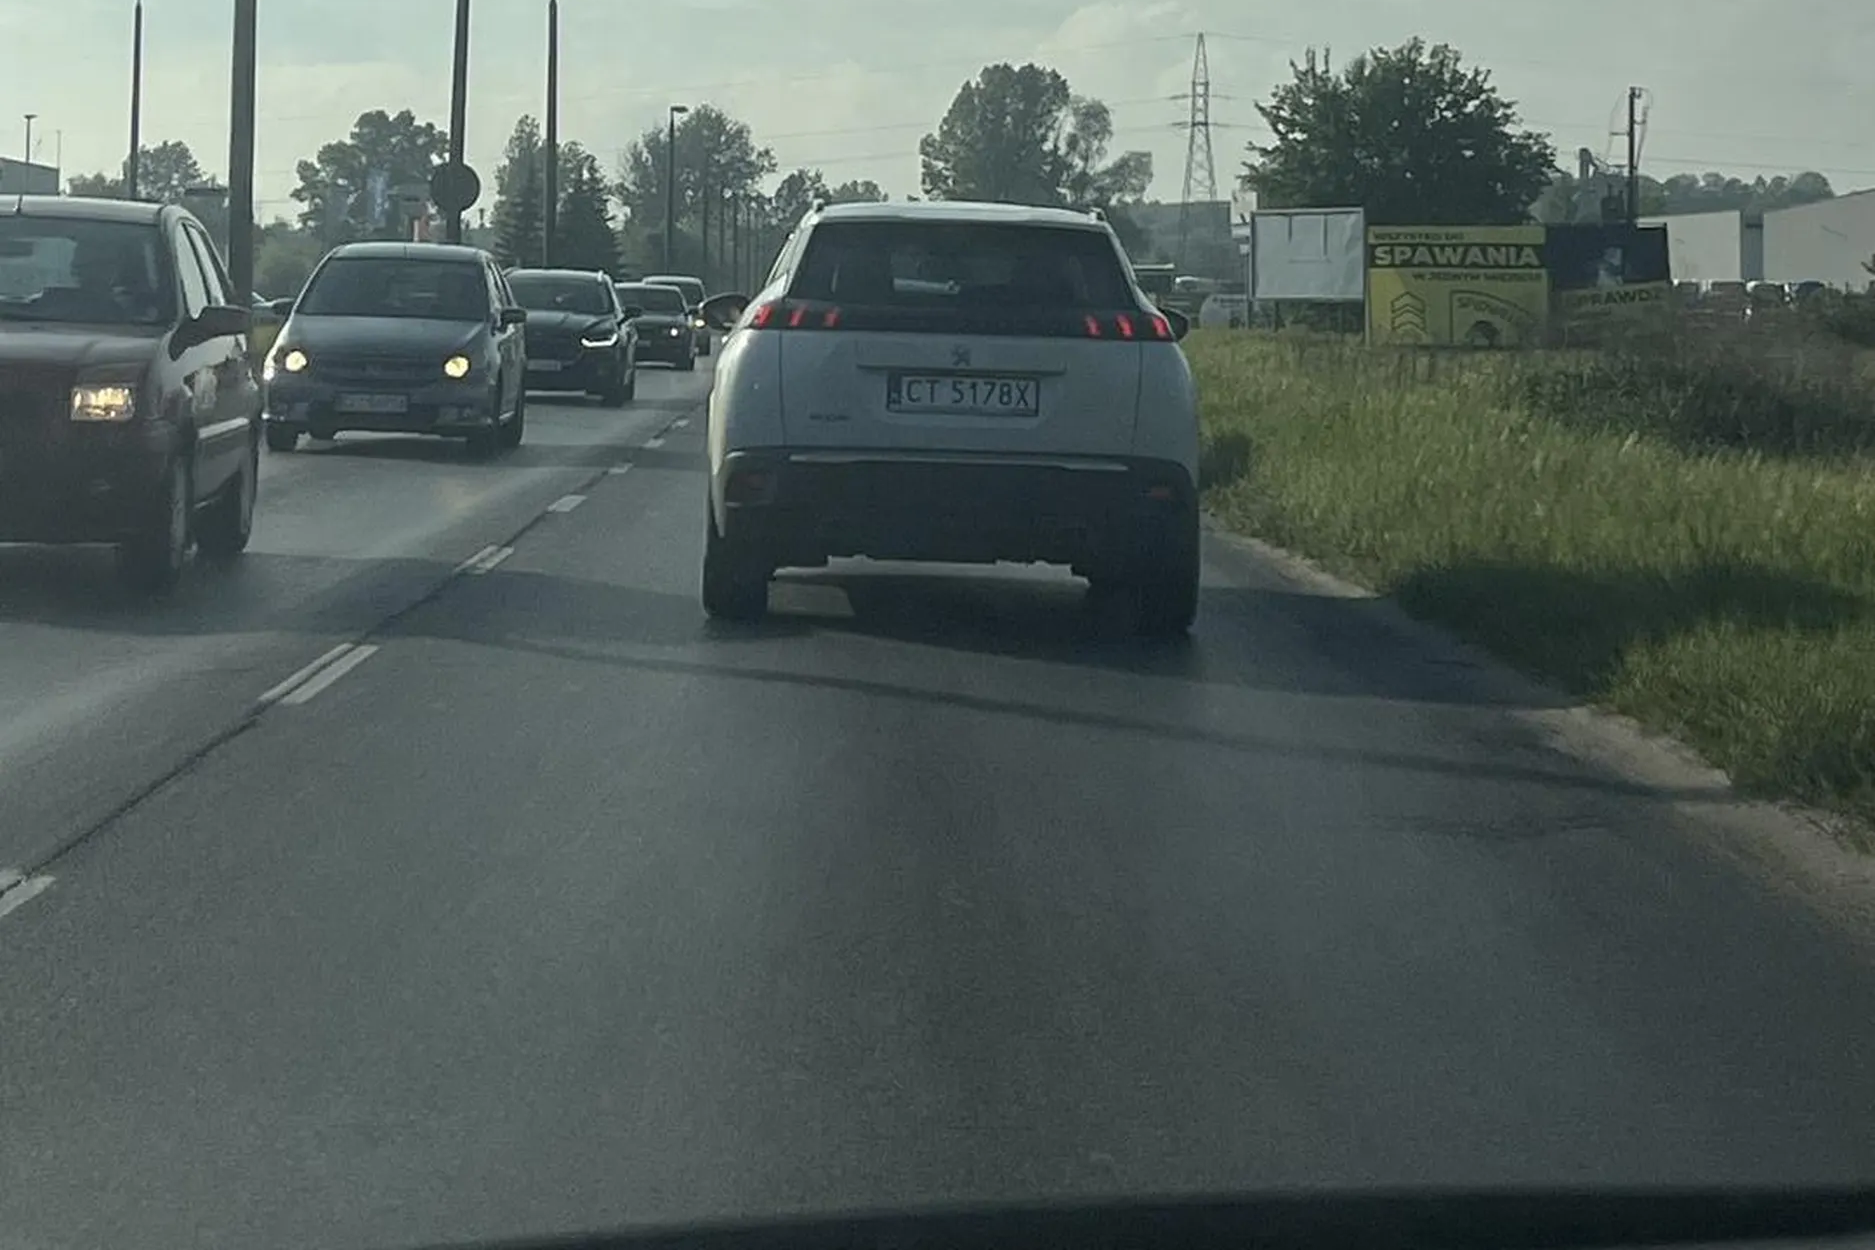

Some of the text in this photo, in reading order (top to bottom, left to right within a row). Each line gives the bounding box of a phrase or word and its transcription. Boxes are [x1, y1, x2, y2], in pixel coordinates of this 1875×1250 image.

[1374, 245, 1541, 266] SPAWANIA
[906, 379, 940, 404] CT
[951, 380, 1030, 407] 5178X
